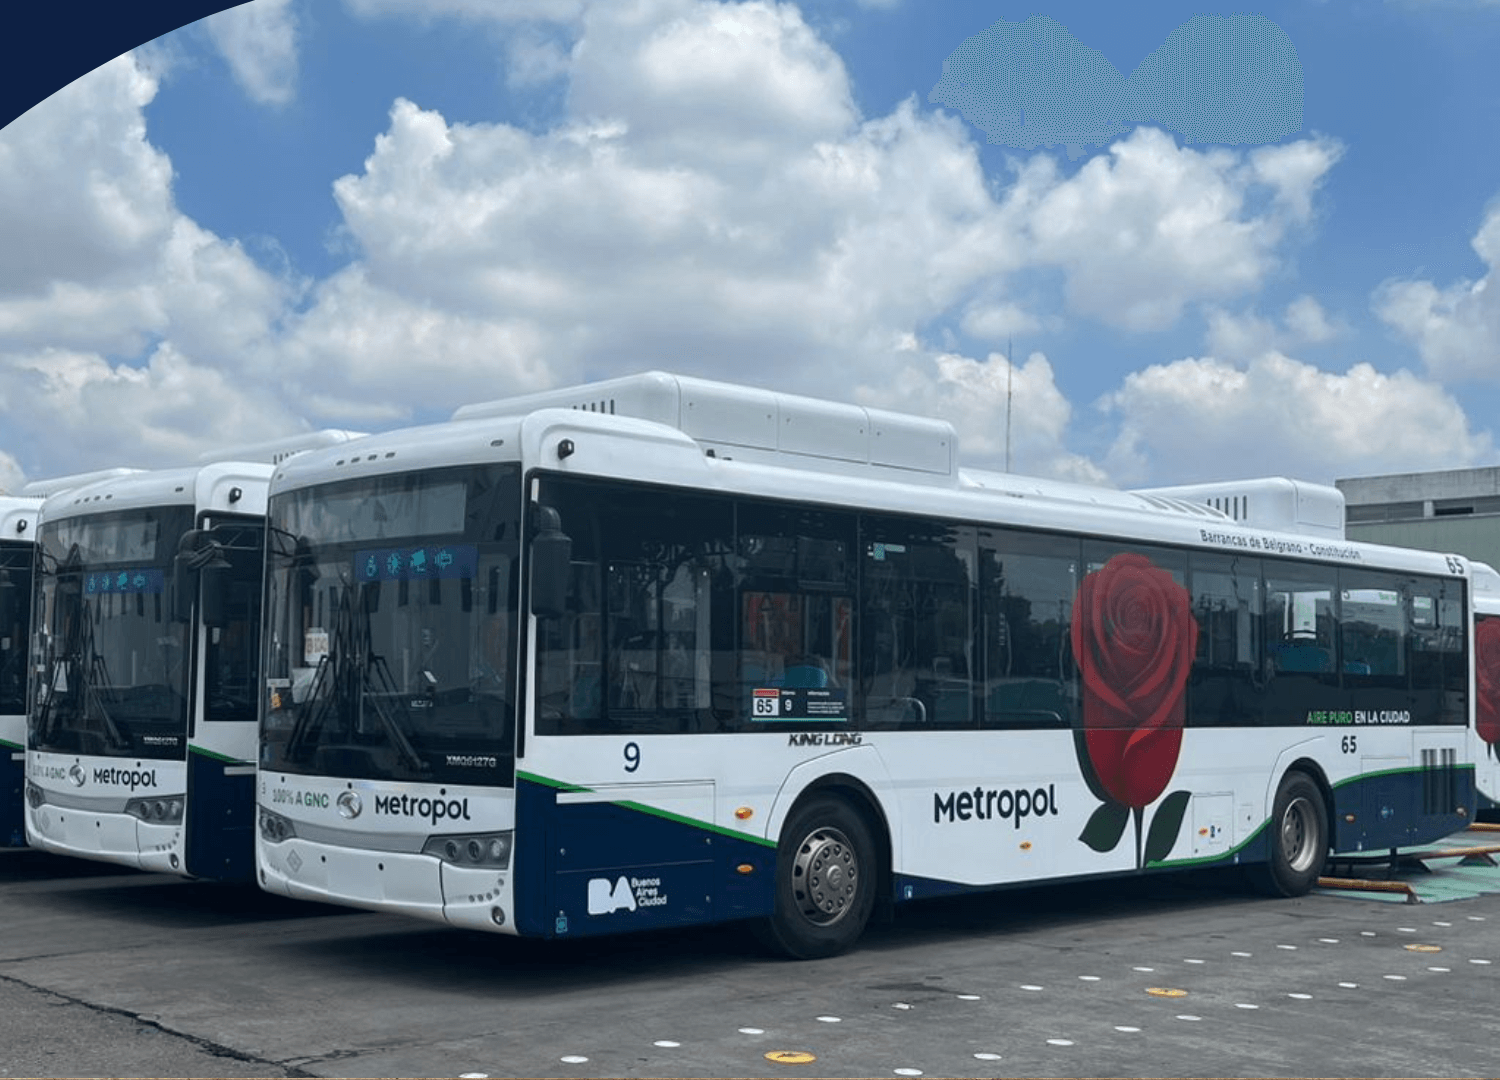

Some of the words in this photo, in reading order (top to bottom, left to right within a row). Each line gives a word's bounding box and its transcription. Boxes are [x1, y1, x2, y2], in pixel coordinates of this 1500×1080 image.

[1200, 529, 1248, 547] Barrancas
[1250, 537, 1261, 548] de
[1262, 537, 1302, 554] Belgrano
[1446, 556, 1465, 575] 65
[756, 699, 773, 713] 65
[785, 699, 792, 711] 9
[1307, 711, 1328, 724] AIRE
[1329, 711, 1353, 724] PURO
[1355, 711, 1366, 723] EN
[1367, 711, 1379, 723] LA
[1380, 711, 1411, 723] CIUDAD
[788, 733, 823, 746] KING
[824, 733, 862, 746] LONG
[1341, 735, 1357, 754] 65
[624, 741, 640, 773] 9
[93, 767, 157, 792] Metropol
[295, 790, 303, 806] A
[304, 791, 329, 809] GNC
[934, 783, 1059, 830] Metropol
[375, 793, 471, 826] Metropol
[631, 877, 661, 888] Buenos
[636, 887, 658, 897] Aires
[587, 876, 637, 915] BA
[638, 894, 668, 907] Ciudad
